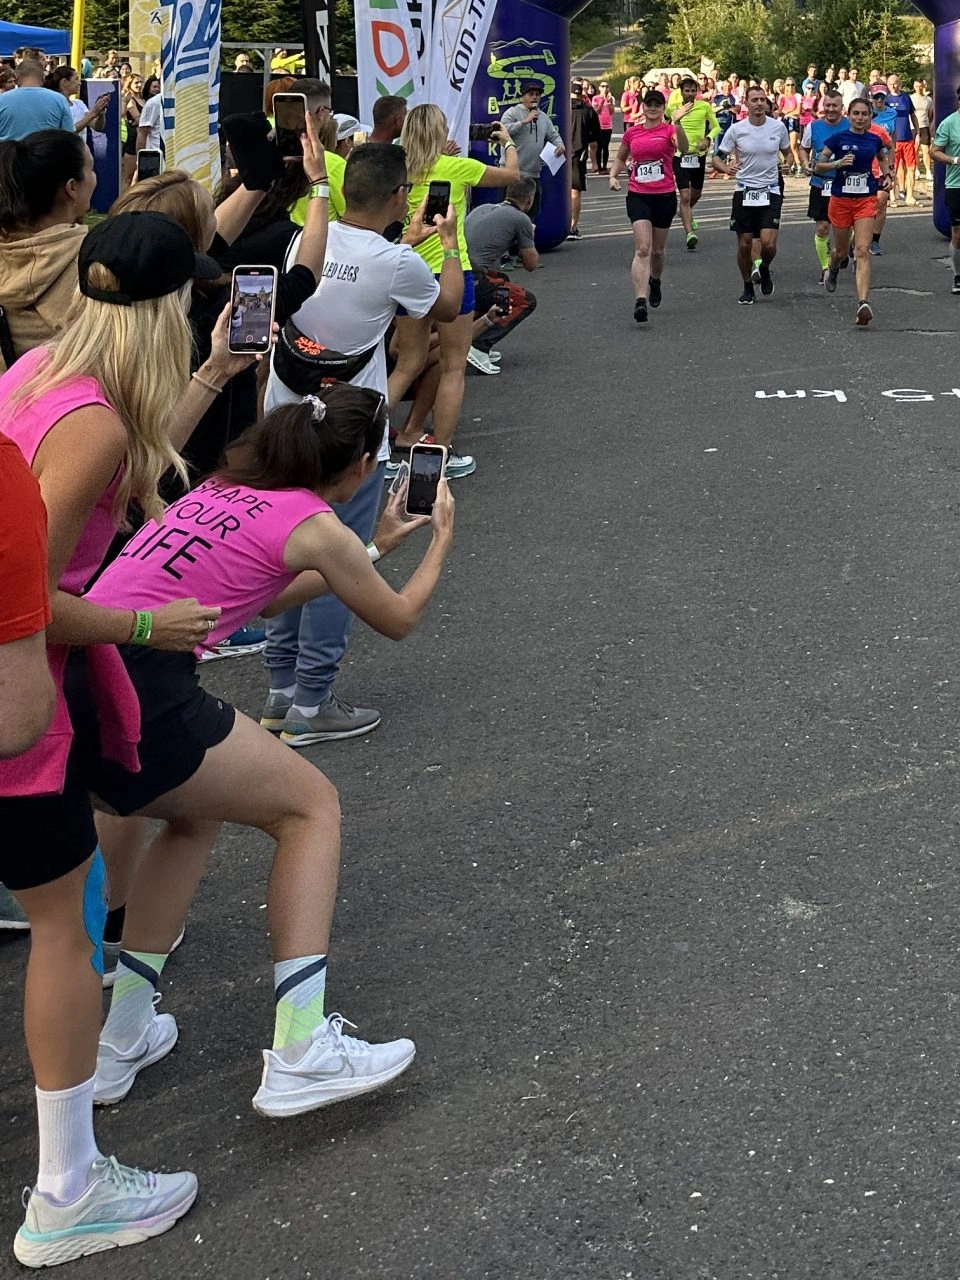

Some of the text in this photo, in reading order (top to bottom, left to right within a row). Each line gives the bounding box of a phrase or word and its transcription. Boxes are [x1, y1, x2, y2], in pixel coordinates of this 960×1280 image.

[640, 167, 653, 176] 134
[847, 177, 861, 187] 019
[337, 264, 360, 282] LEGS
[193, 480, 273, 520] SHAPE
[165, 499, 241, 540] YOUR
[119, 522, 213, 581] LIFE
